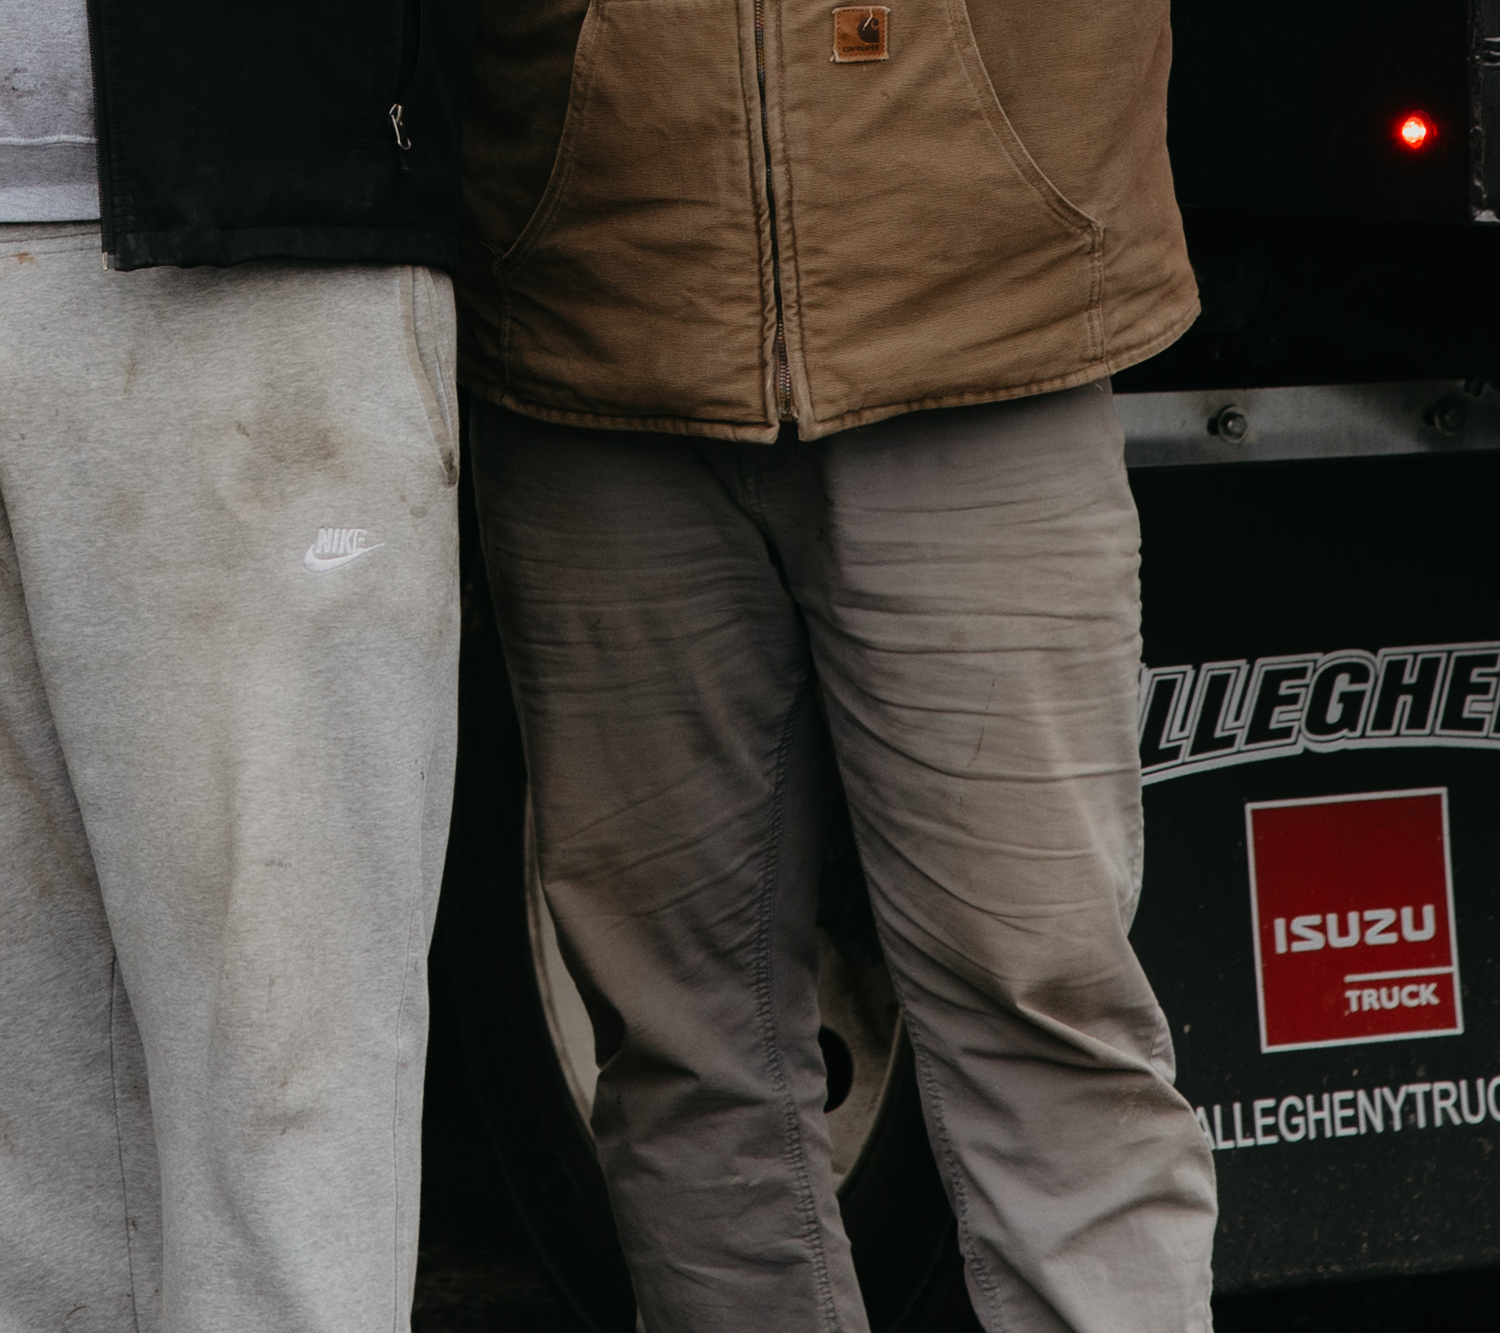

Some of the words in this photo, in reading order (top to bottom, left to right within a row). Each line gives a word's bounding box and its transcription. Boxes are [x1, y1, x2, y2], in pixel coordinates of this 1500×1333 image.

[315, 527, 367, 554] NIKE
[1274, 904, 1436, 954] ISUZU
[1344, 981, 1440, 1015] TRUCK
